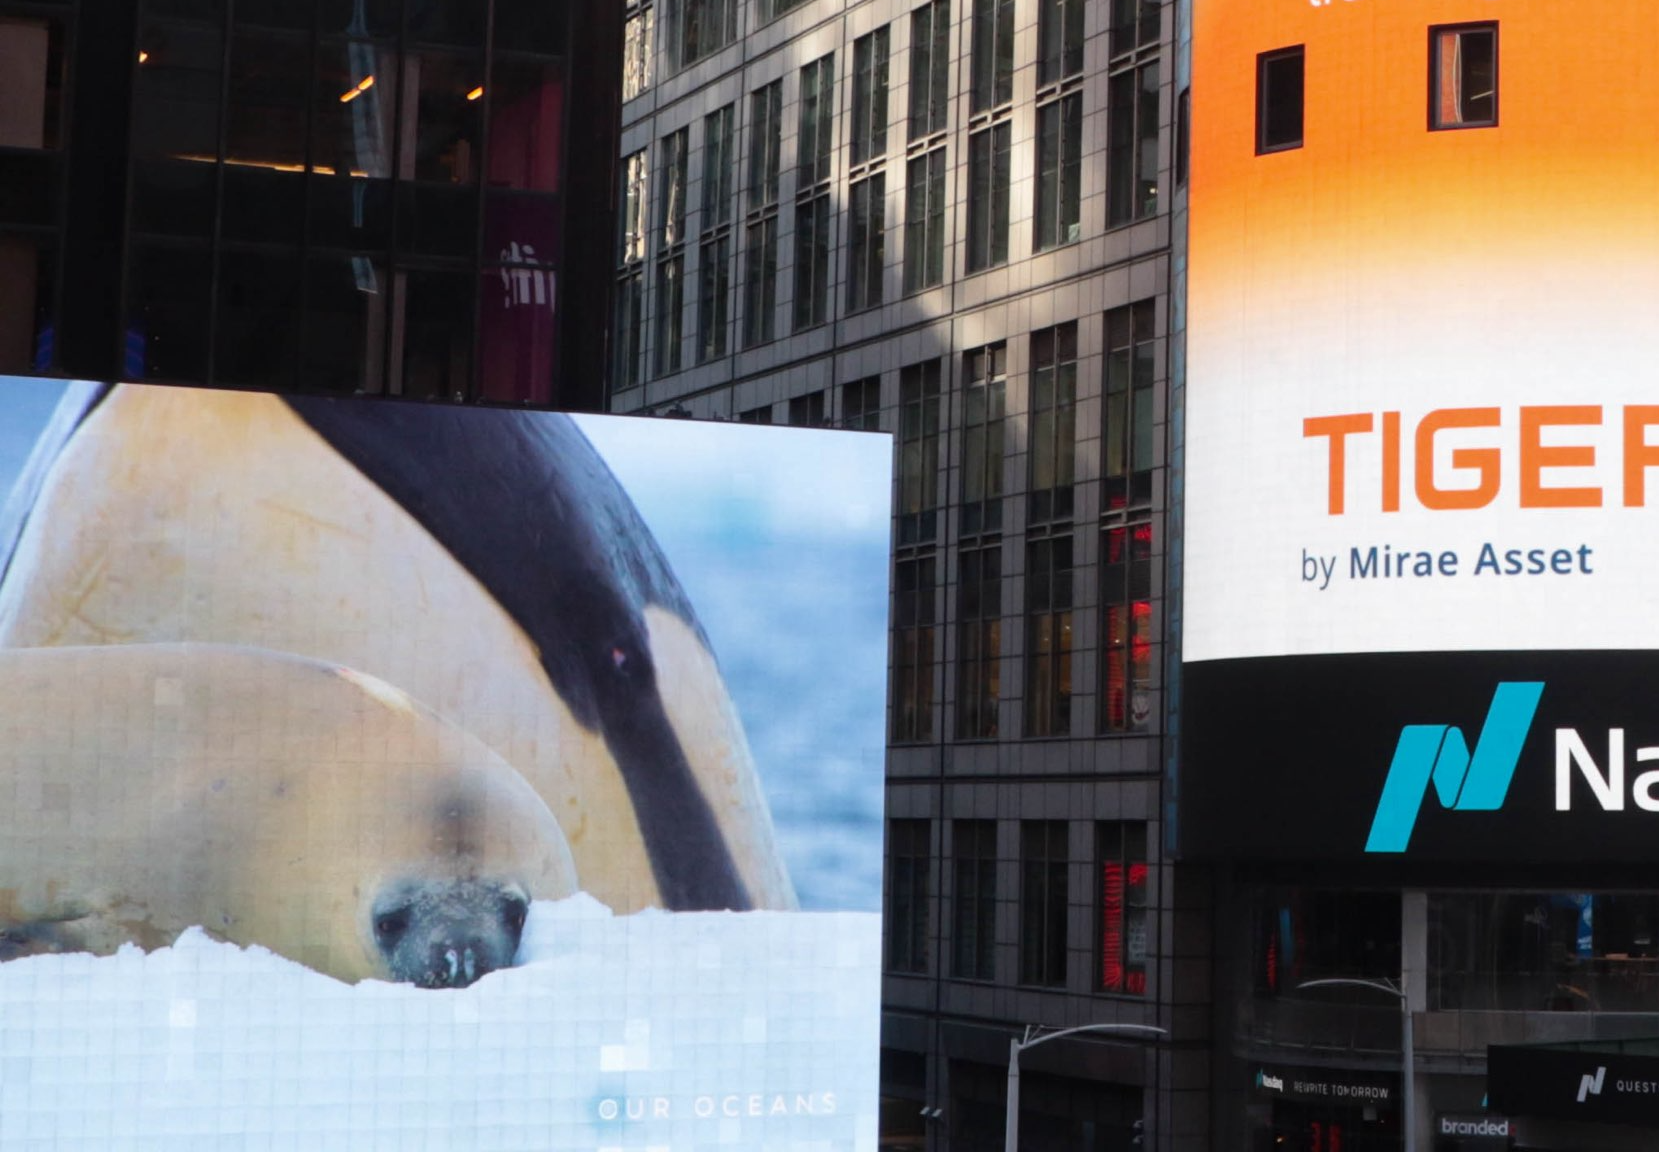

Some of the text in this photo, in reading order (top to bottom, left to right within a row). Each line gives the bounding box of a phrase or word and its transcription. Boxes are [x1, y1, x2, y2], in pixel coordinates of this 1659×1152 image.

[1301, 542, 1594, 590] by Mirae Asset
[599, 1092, 837, 1120] OUR OCEANS
[1441, 1117, 1509, 1136] branded
